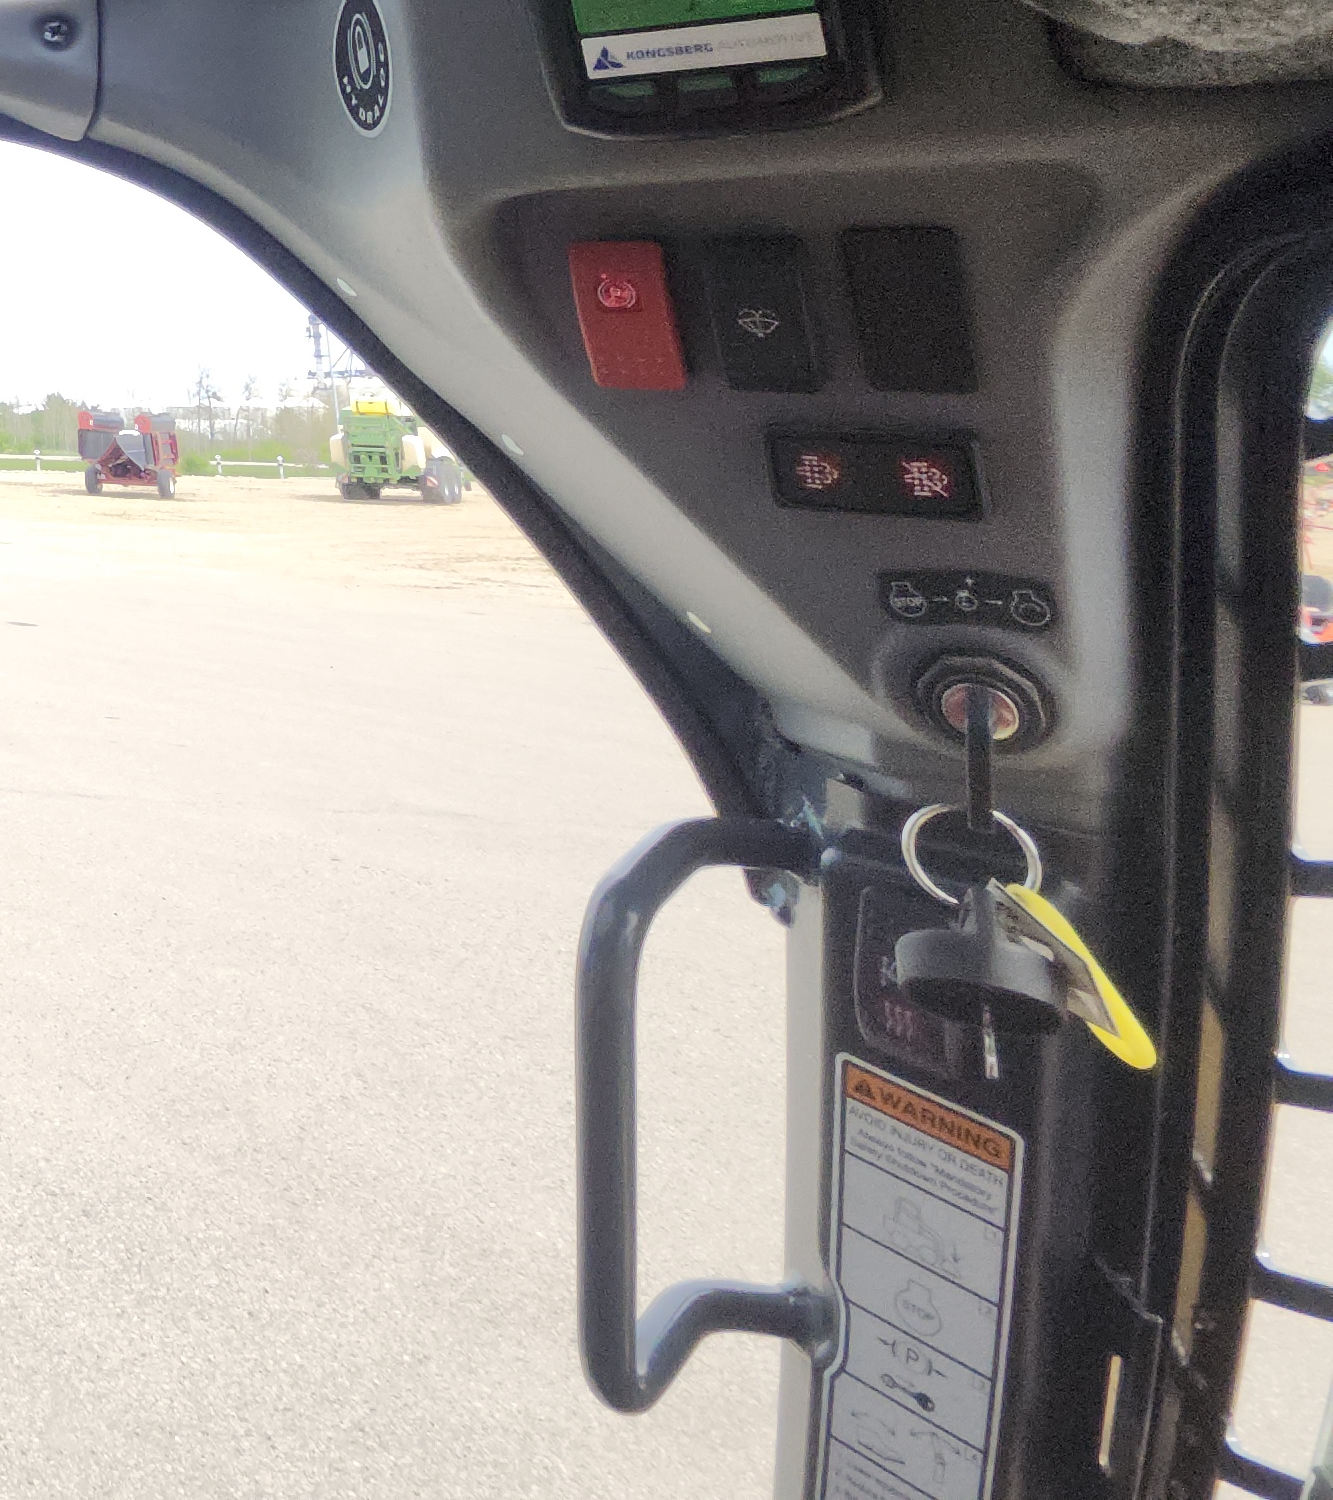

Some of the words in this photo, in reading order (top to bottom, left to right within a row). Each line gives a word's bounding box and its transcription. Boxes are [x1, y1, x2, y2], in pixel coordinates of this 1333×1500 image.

[626, 42, 714, 61] KONGSBERG
[848, 1104, 886, 1132] AVOID
[890, 1123, 933, 1154] INJURY
[937, 1146, 956, 1165] OR
[959, 1156, 1003, 1188] DEATH
[879, 1086, 1000, 1160] WARNING
